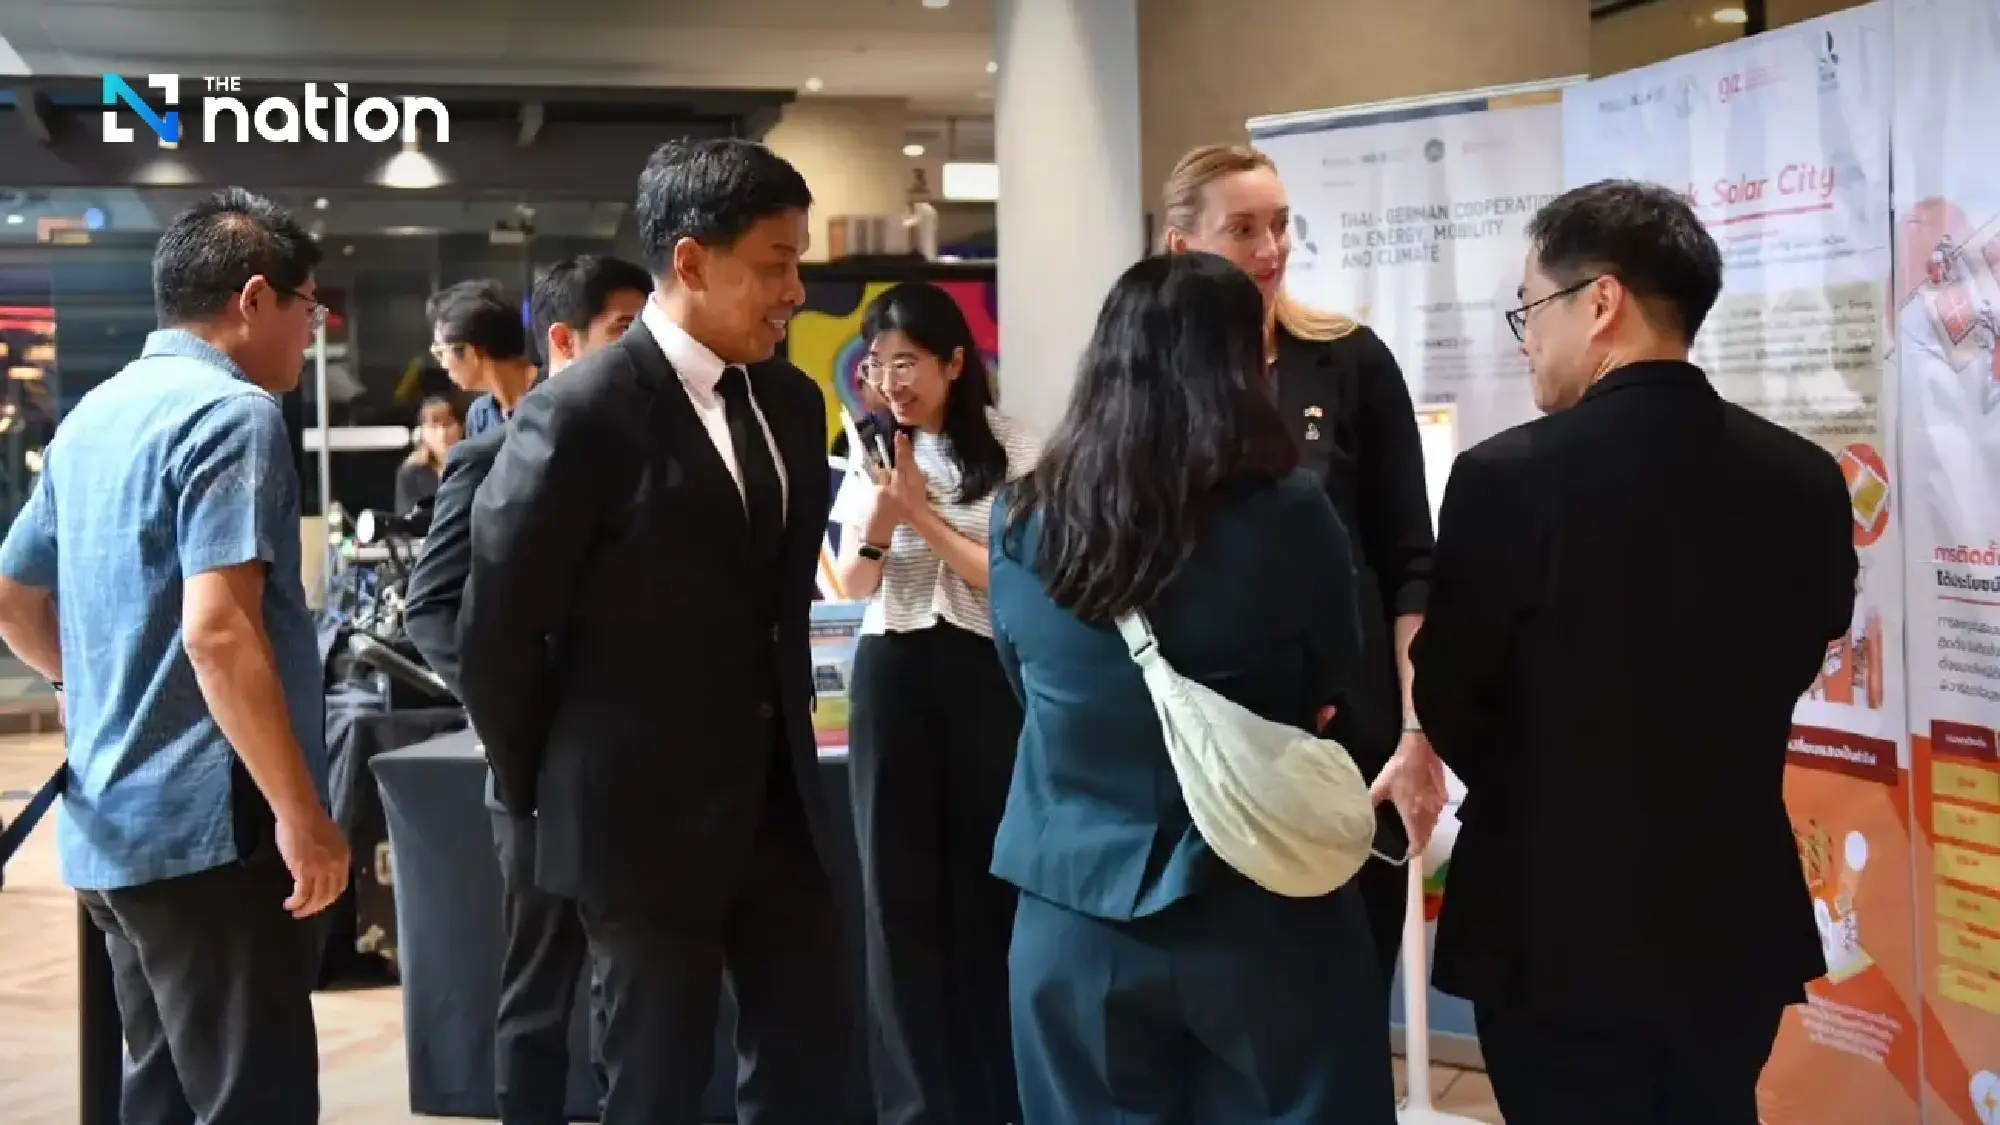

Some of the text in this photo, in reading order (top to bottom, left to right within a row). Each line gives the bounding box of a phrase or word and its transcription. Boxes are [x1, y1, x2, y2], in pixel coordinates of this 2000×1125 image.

[1713, 172, 1768, 206] Solar
[1778, 162, 1835, 198] City
[1454, 193, 1557, 218] COOPERATIO
[1433, 218, 1504, 240] MOBILITY
[1341, 243, 1441, 269] AND CLIMATE
